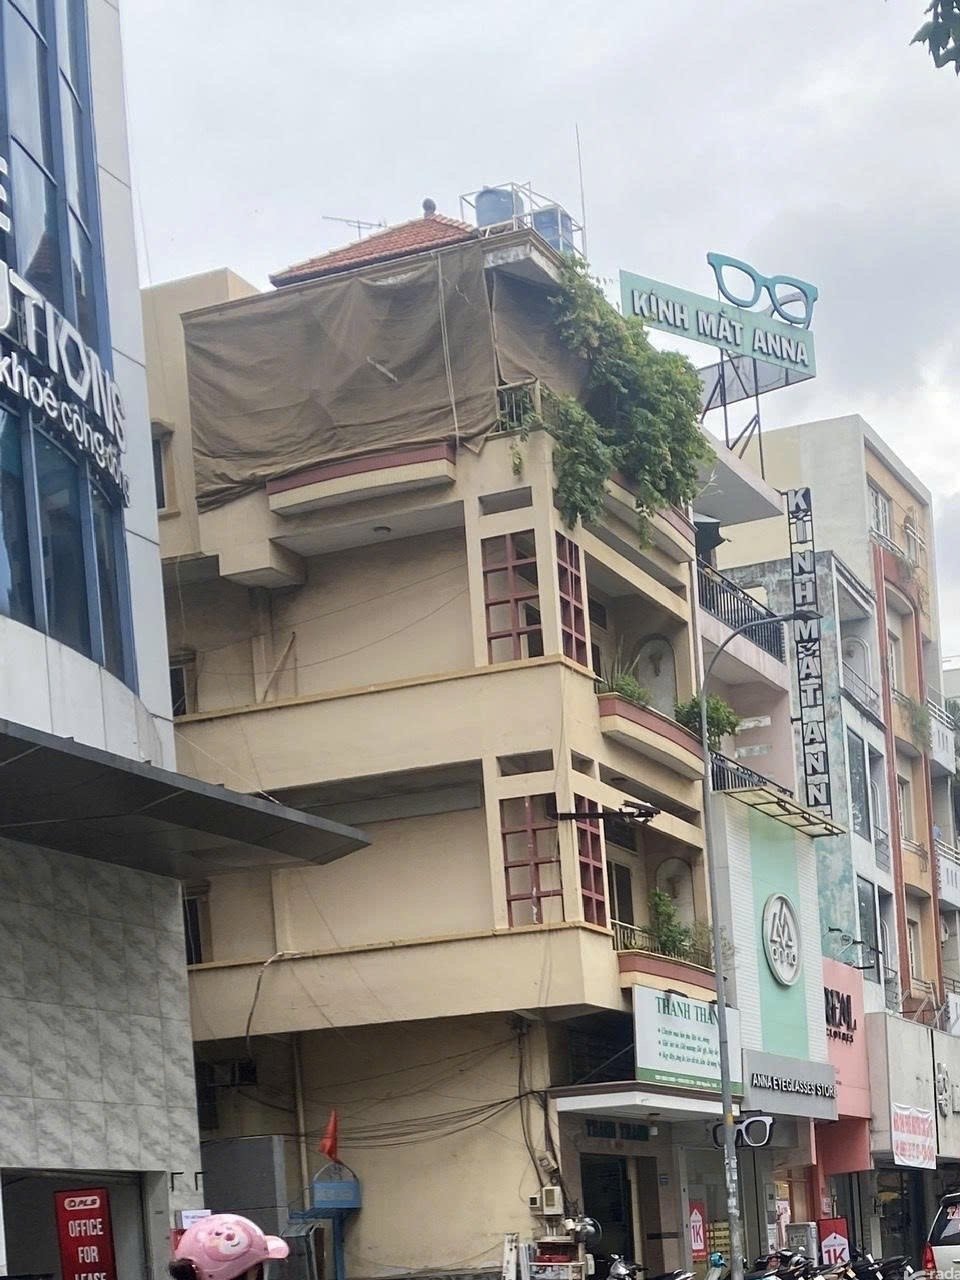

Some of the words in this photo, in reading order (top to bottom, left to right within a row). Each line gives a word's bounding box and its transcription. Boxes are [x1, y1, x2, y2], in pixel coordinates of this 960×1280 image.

[631, 288, 690, 330] KÍNH
[752, 328, 809, 368] ANNA
[803, 720, 832, 818] ANN
[655, 996, 691, 1020] THANH
[694, 1003, 719, 1026] THAN
[751, 1073, 772, 1090] ANNA
[773, 1076, 815, 1096] EYEGLASSES
[68, 1218, 104, 1237] OFFICE
[692, 1224, 703, 1243] 1K
[78, 1246, 99, 1263] FOR
[824, 1247, 847, 1264] 1K
